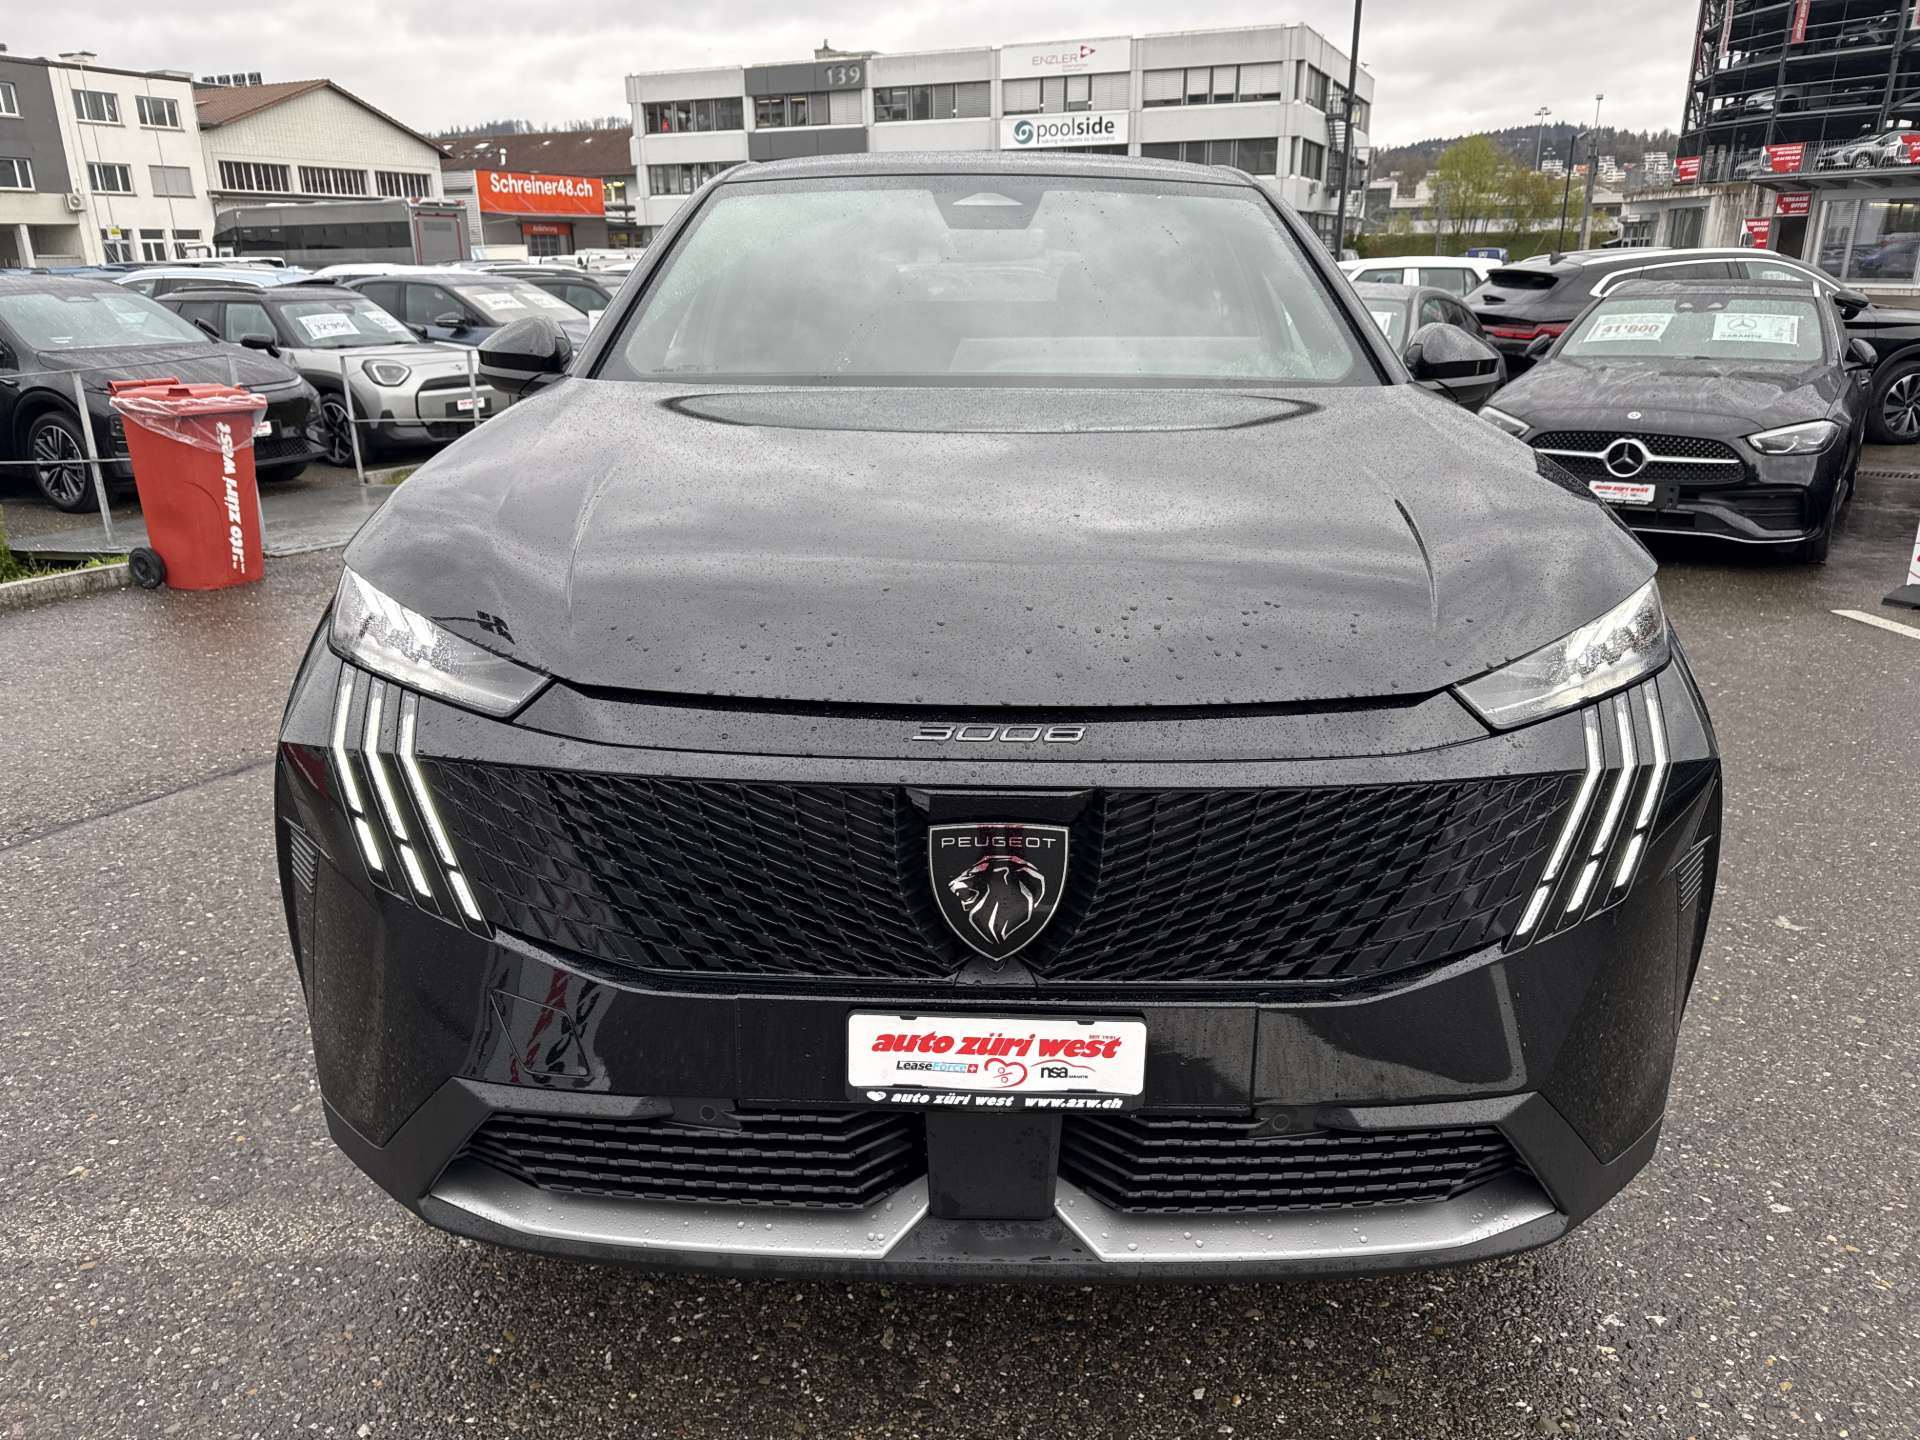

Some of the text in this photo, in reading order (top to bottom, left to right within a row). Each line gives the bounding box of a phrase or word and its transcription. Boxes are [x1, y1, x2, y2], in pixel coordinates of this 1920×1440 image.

[1032, 53, 1078, 66] ENZLER
[825, 66, 861, 85] 139
[1037, 116, 1115, 145] poolside
[490, 172, 593, 197] Schreiner48.ch
[912, 725, 1087, 743] 3008
[941, 836, 1057, 849] PEUGEOT
[872, 1031, 1122, 1059] auto züri west
[896, 1060, 966, 1073] LeaseForce
[1041, 1065, 1068, 1079] nsa
[891, 1092, 1123, 1109] auto züri west www.azw.ch
